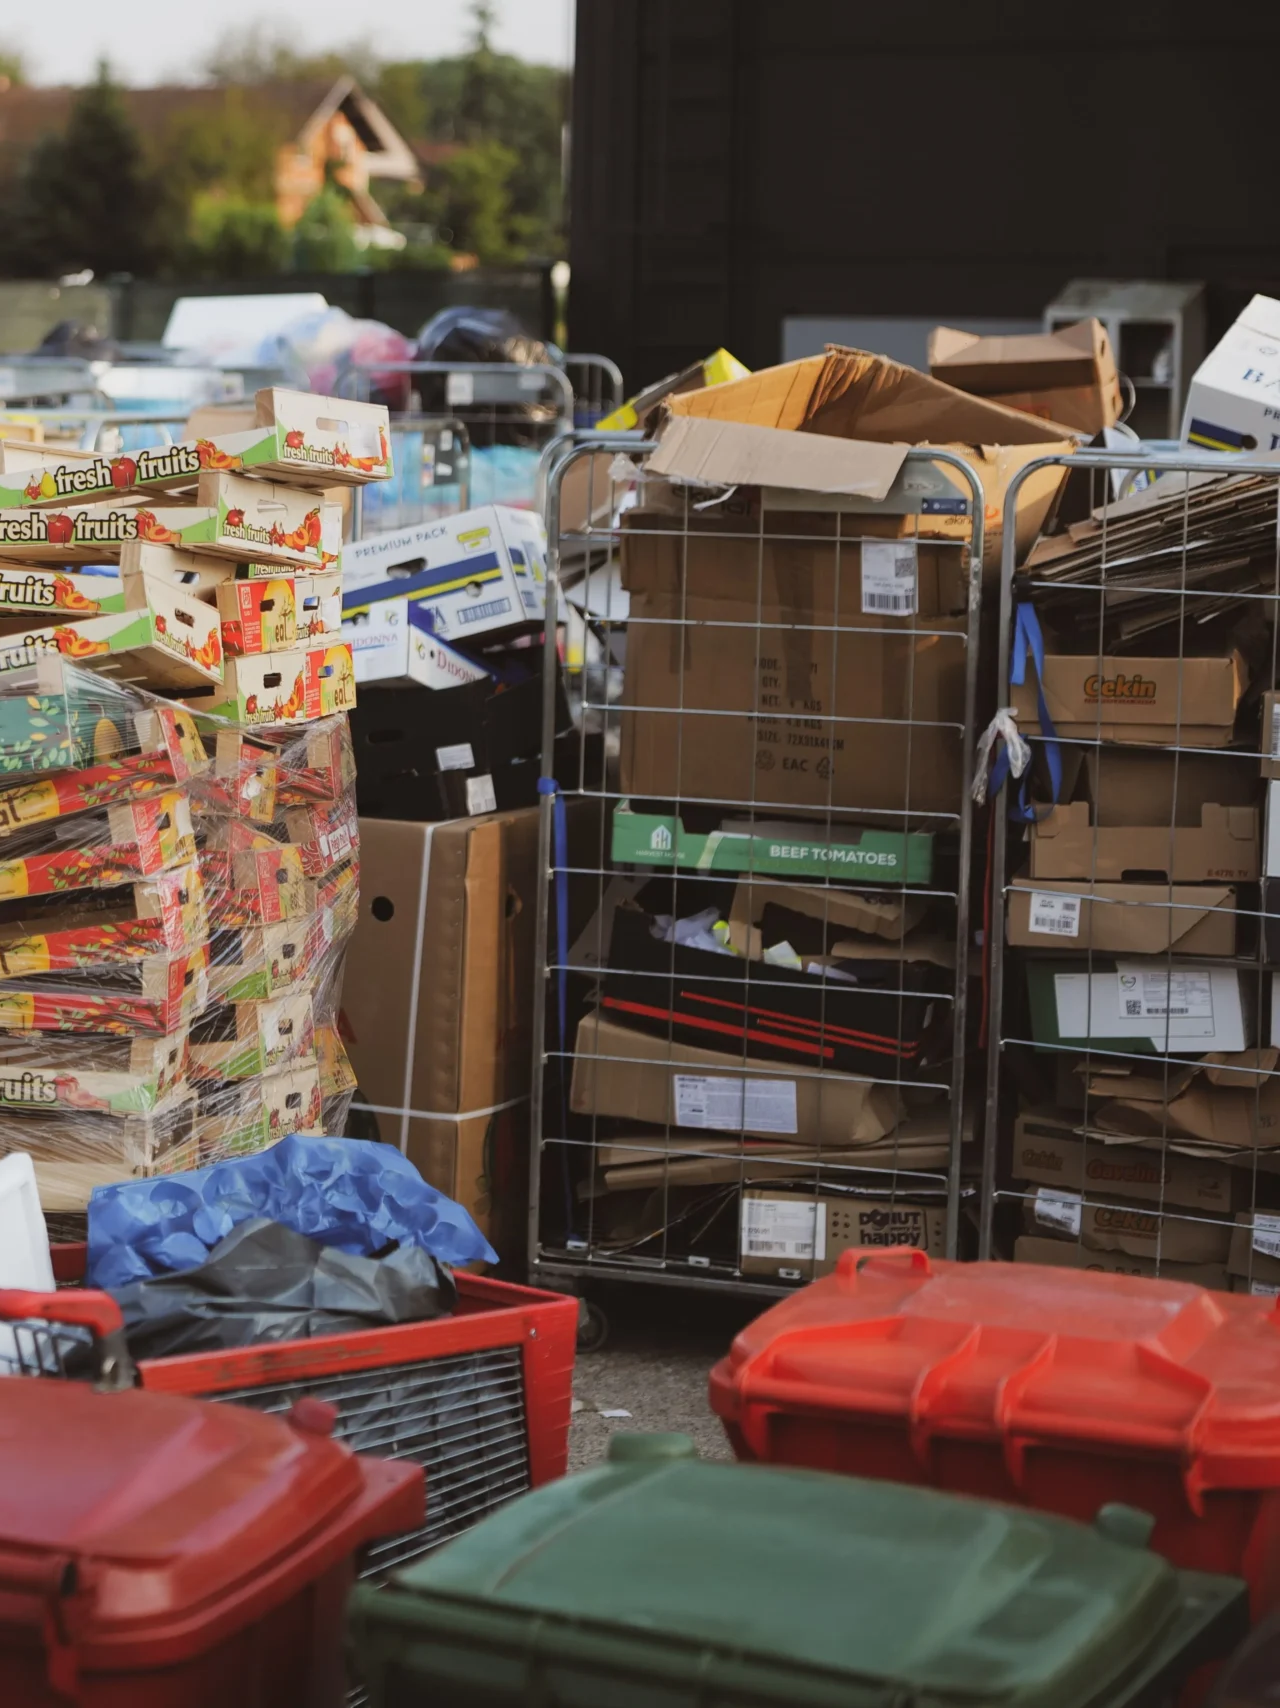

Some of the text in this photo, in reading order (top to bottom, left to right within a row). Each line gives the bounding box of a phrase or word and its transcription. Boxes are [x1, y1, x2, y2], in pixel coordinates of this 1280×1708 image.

[283, 443, 334, 465] fresh fruits
[55, 446, 200, 495] fresh fruits
[74, 511, 138, 541] fruits
[223, 519, 271, 545] fresh fruits
[355, 526, 448, 558] PREMIUM PACK
[353, 633, 399, 647] IDONNA
[1083, 673, 1157, 698] Cekin
[782, 756, 809, 772] EAC
[769, 844, 898, 866] BEEF TOMATOES
[860, 1229, 920, 1248] happy
